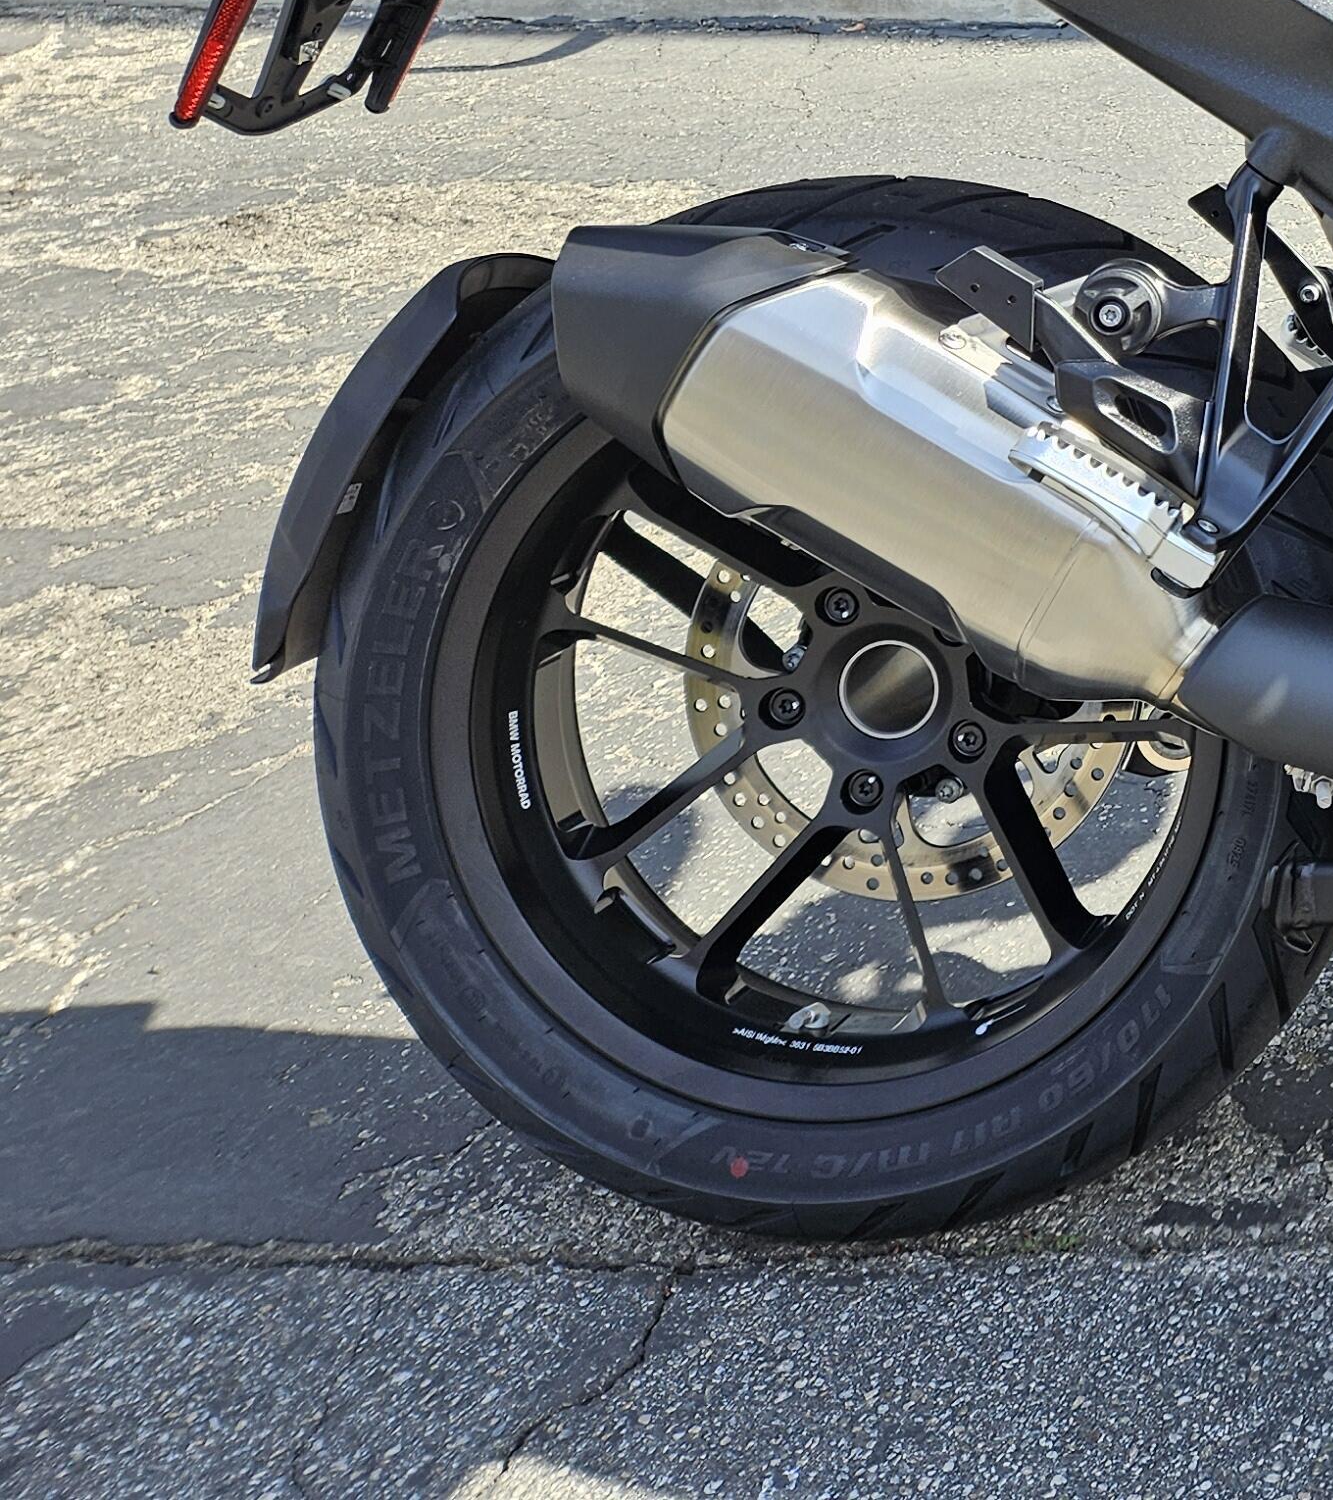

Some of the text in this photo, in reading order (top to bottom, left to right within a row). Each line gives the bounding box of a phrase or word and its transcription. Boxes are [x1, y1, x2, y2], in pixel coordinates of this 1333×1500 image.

[358, 532, 432, 887] METZELER
[508, 710, 531, 810] BMW MOTORRAD
[1031, 981, 1177, 1114] 170/60
